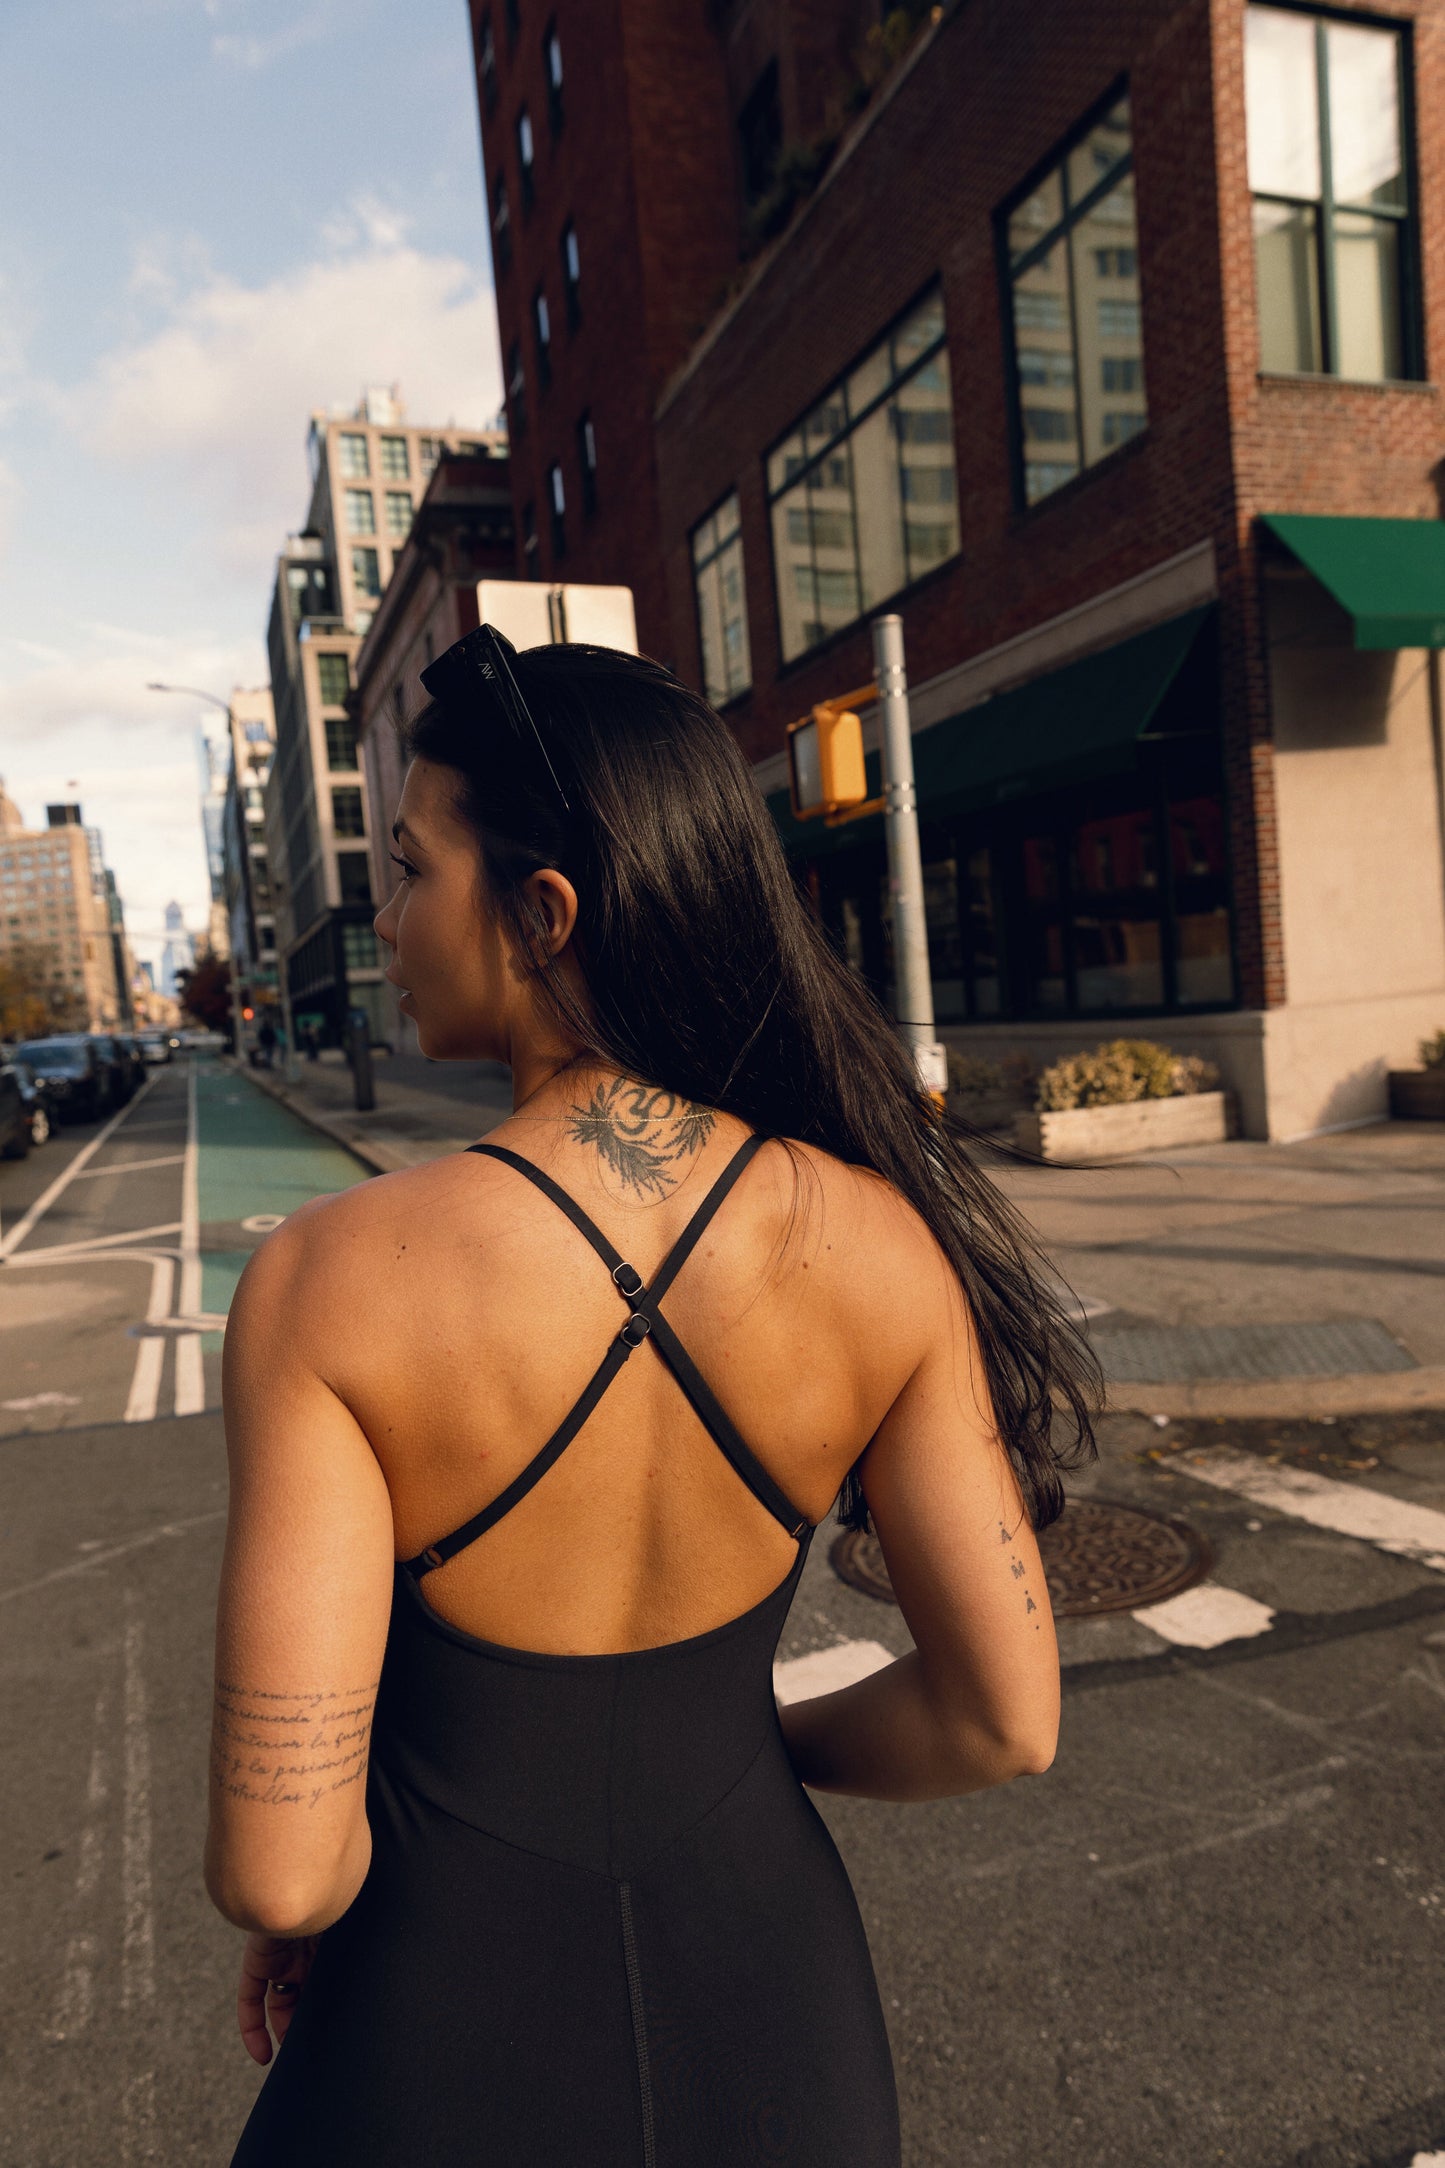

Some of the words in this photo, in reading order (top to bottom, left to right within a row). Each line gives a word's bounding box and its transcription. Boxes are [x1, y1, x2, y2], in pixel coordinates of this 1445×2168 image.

[309, 1732, 331, 1750] la
[248, 1757, 271, 1775] la
[308, 1787, 326, 1809] y
